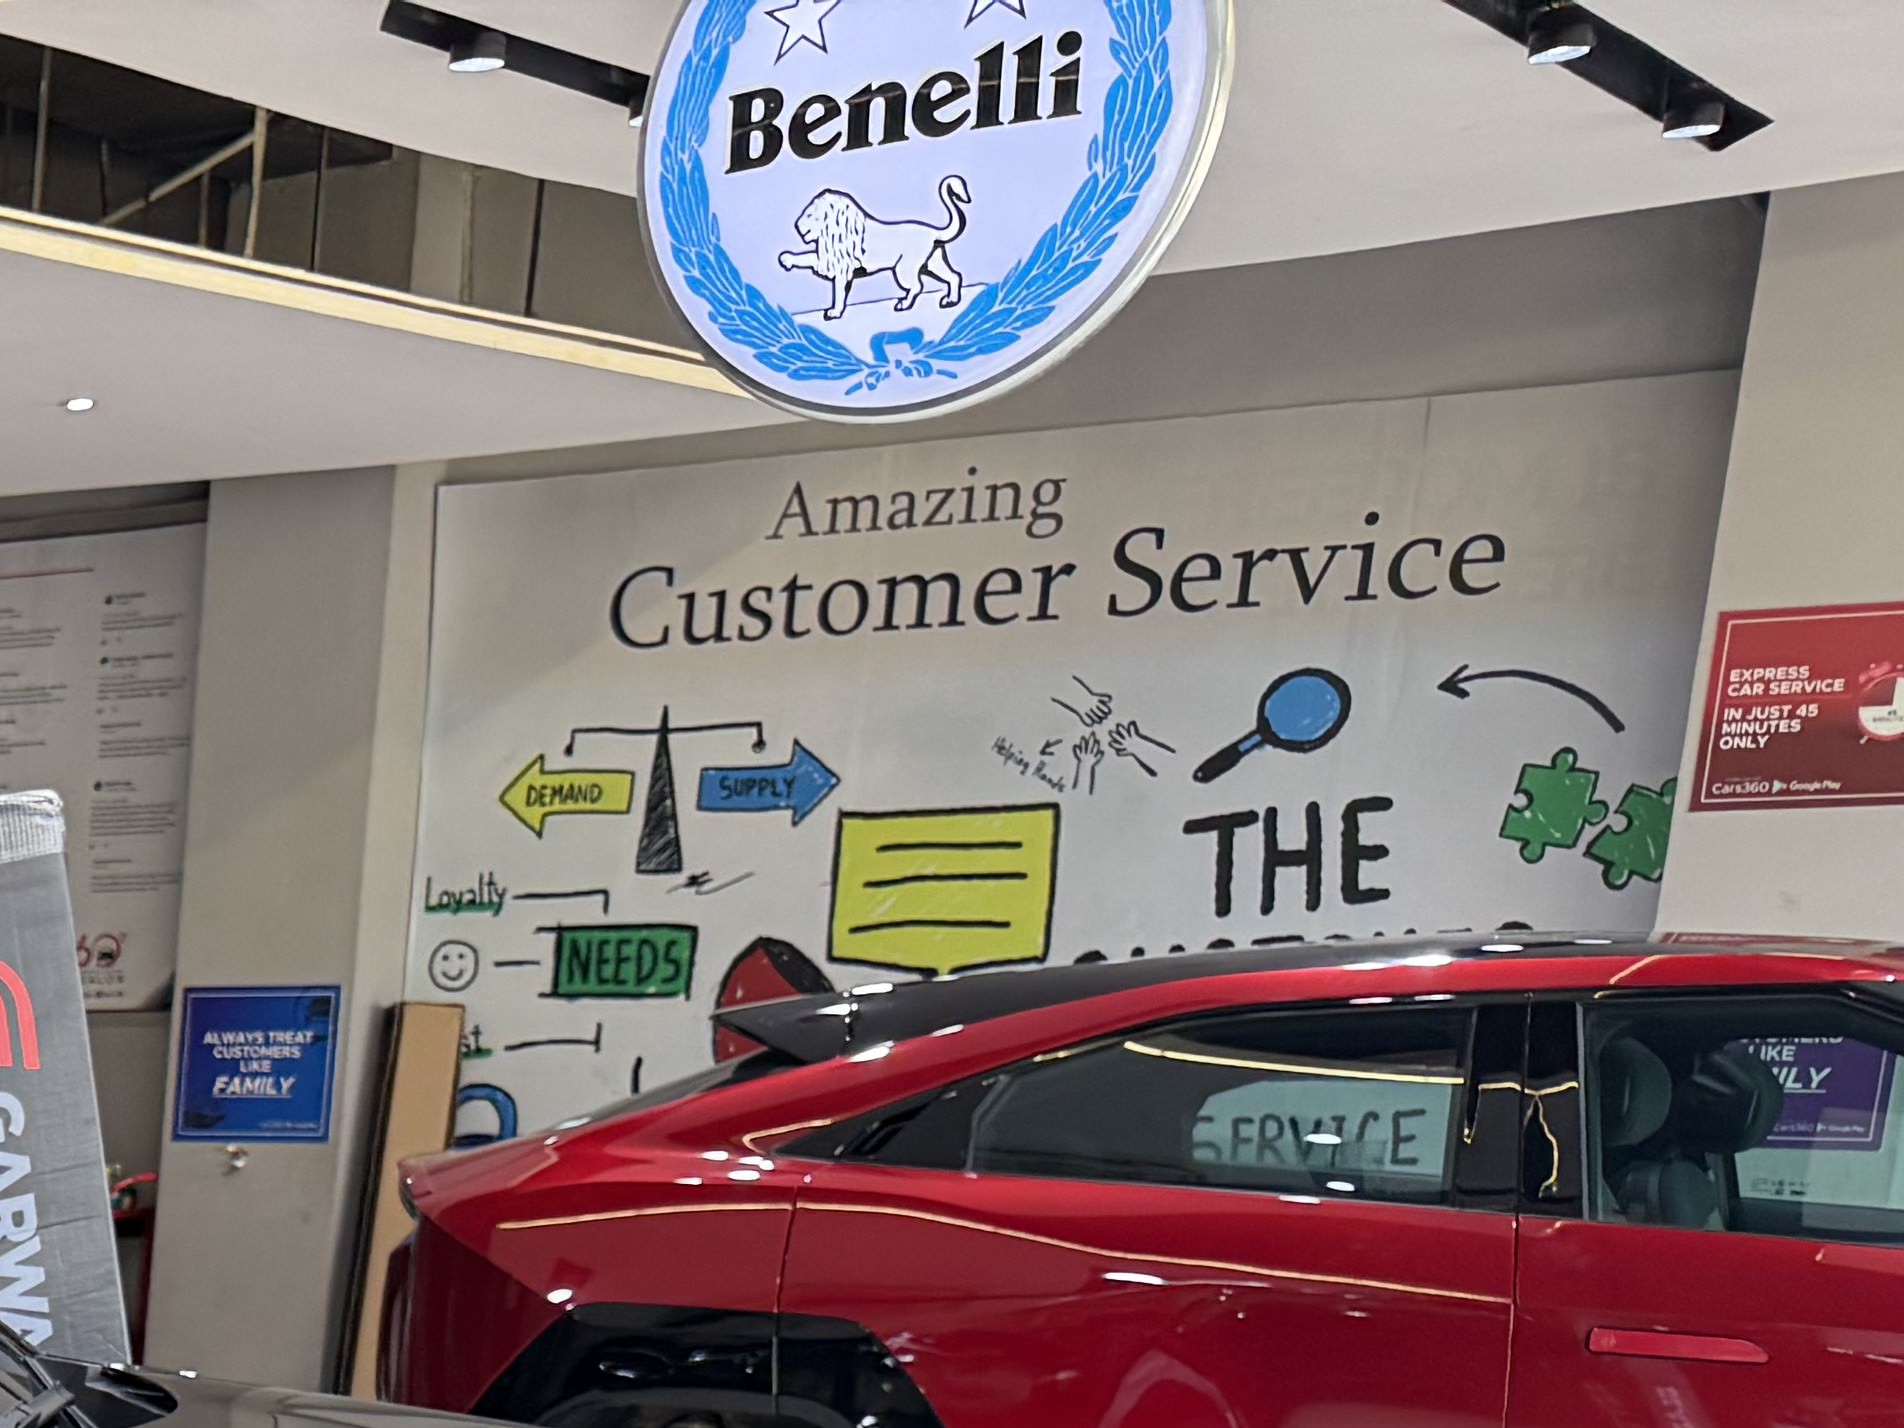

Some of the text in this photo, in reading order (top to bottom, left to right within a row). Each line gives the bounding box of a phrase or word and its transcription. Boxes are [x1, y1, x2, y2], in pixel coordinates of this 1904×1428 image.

[724, 31, 1084, 175] Benelli
[766, 467, 1069, 546] Amazing
[610, 510, 1507, 648] Customer Service
[1729, 665, 1810, 682] EXPRESS
[1727, 678, 1845, 697] CAR SERVICE
[1724, 703, 1819, 721] IN JUST 45
[1721, 718, 1801, 735] MINUTES
[1719, 735, 1769, 750] ONLY
[525, 776, 794, 807] DEMAND SUPPLY
[1712, 779, 1842, 795] Cars360 Google Play
[1182, 796, 1395, 917] THE
[424, 872, 508, 915] Loyalty
[566, 937, 683, 986] NEEDS
[203, 1031, 314, 1045] ALWAYS TREAT
[212, 1046, 302, 1059] CUSTOMERS
[239, 1060, 272, 1073] LIKE
[212, 1076, 296, 1096] FAMILY
